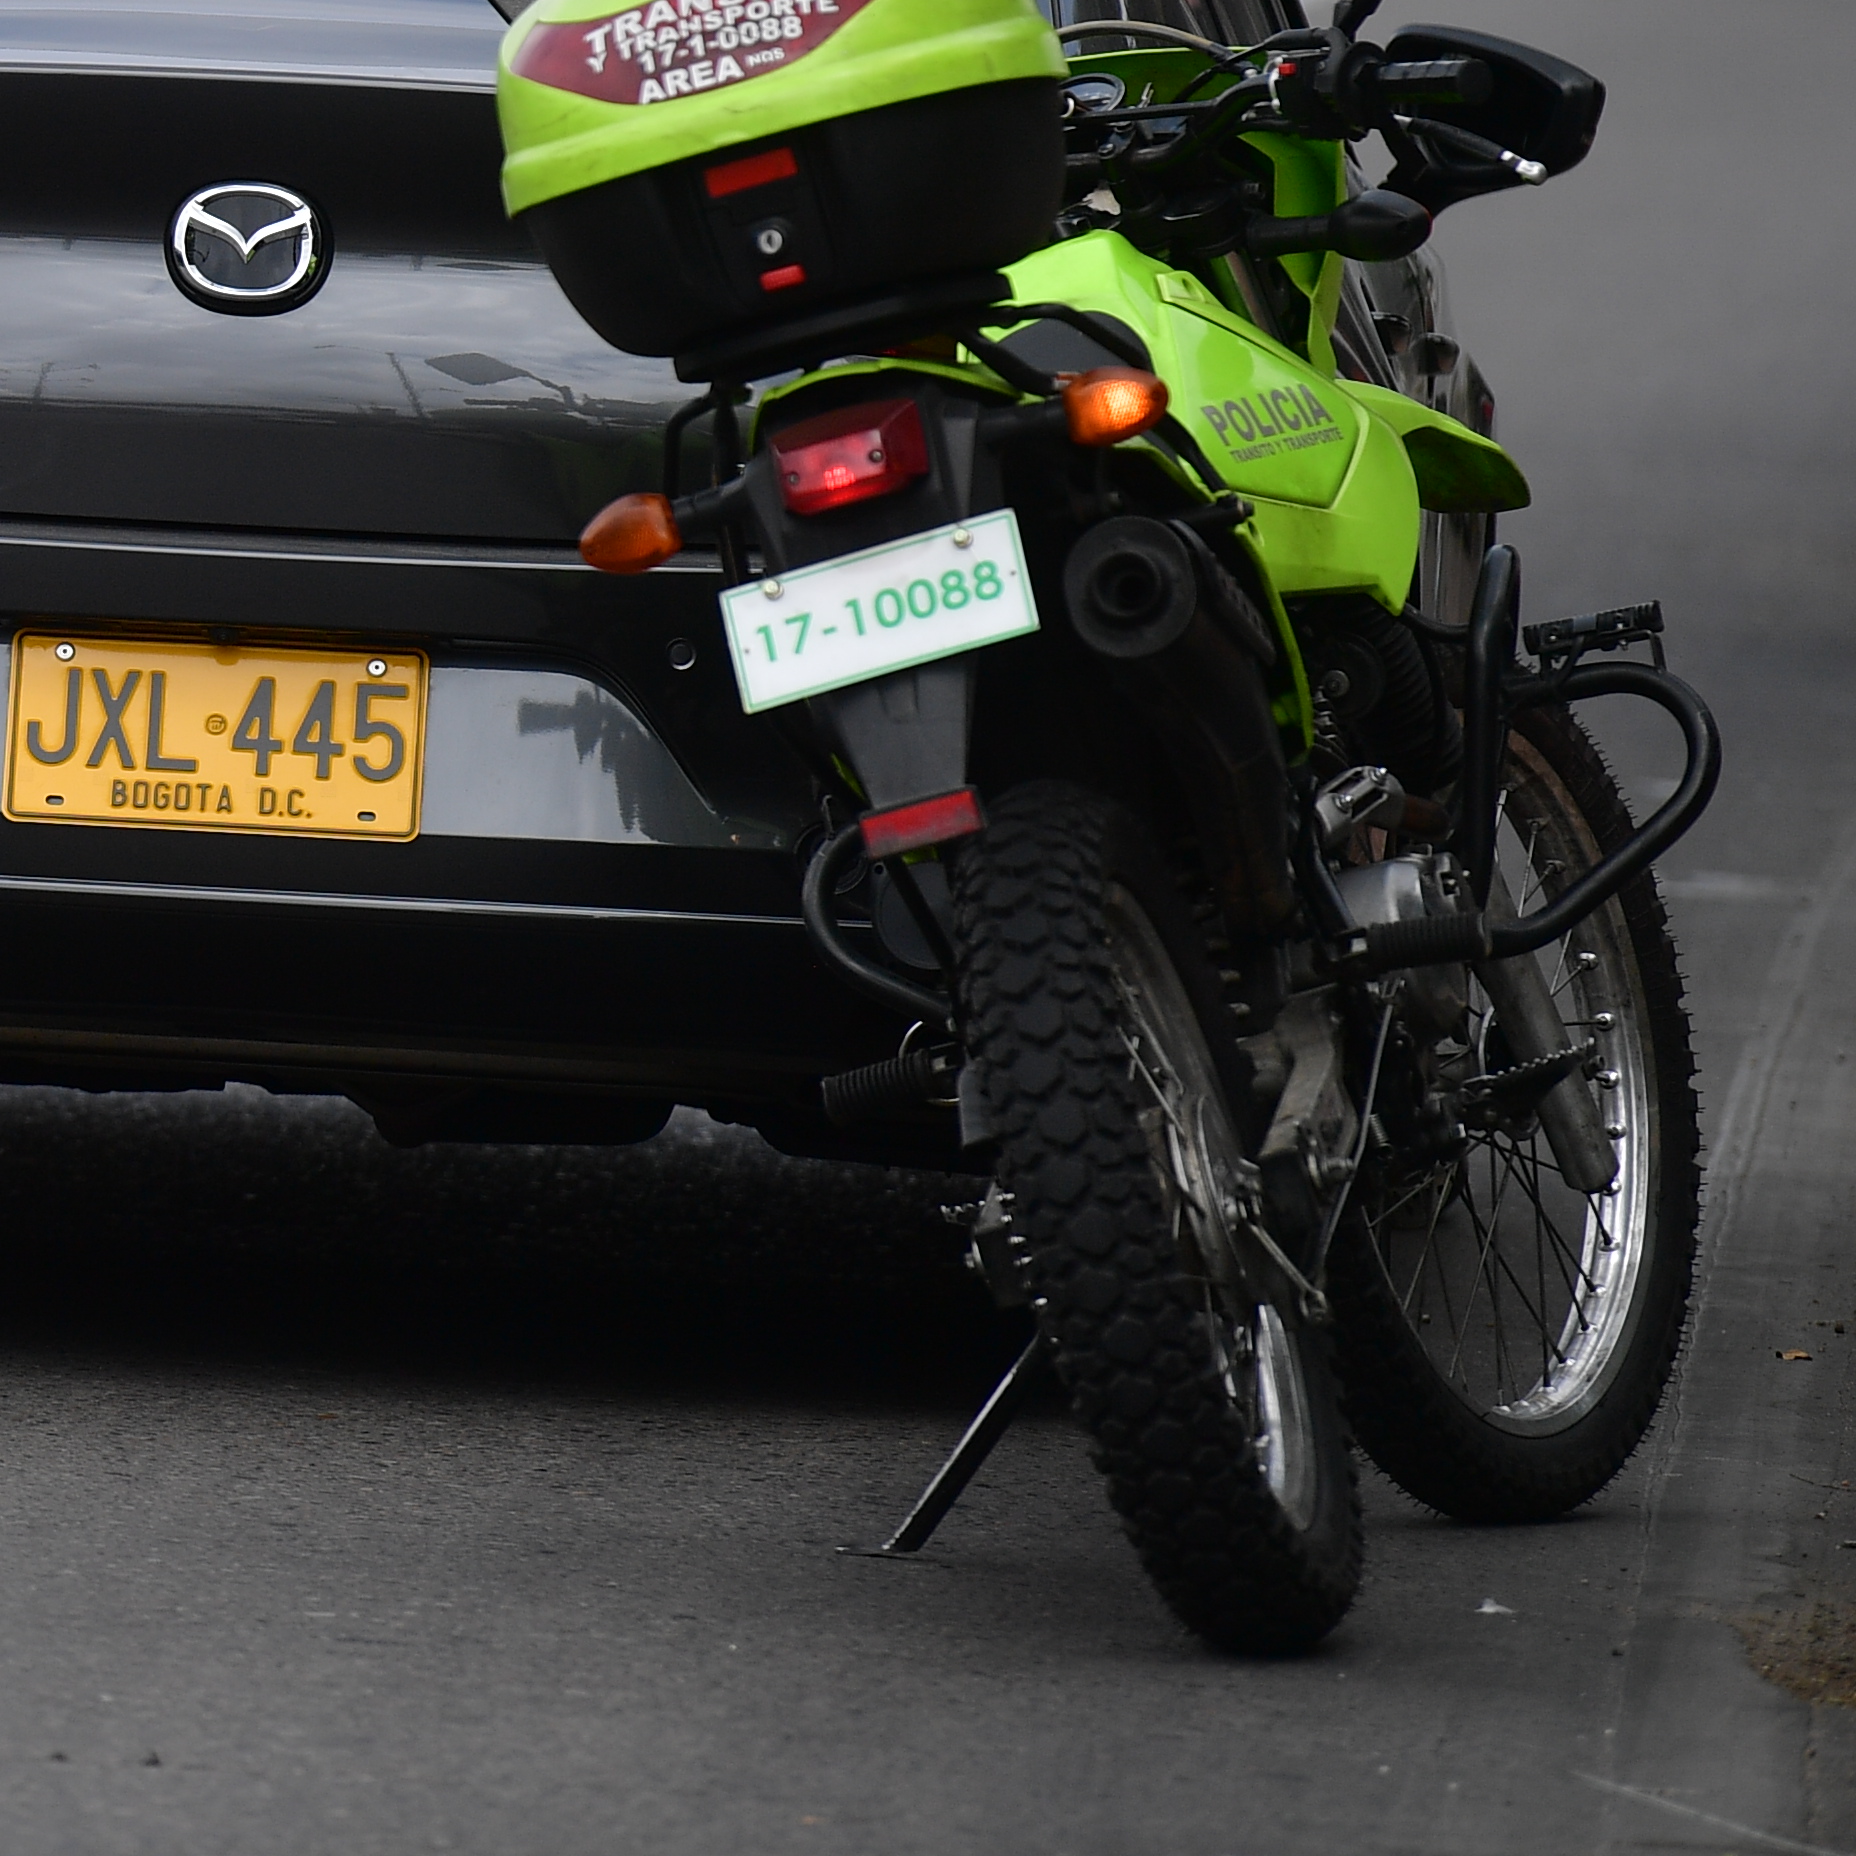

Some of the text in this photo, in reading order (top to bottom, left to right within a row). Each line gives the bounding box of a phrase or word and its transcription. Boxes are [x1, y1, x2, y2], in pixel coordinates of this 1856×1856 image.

[586, 50, 608, 74] Y
[637, 15, 804, 75] 17-1-0088
[639, 46, 786, 105] AREA NQS
[1200, 382, 1335, 447] POLICIA
[1229, 442, 1277, 463] TRANSITO
[1283, 426, 1345, 451] TRANSPORTE
[756, 559, 1005, 663] 17-10088
[25, 666, 410, 783] JXL 445
[110, 778, 314, 819] BOGOTA D.C.
